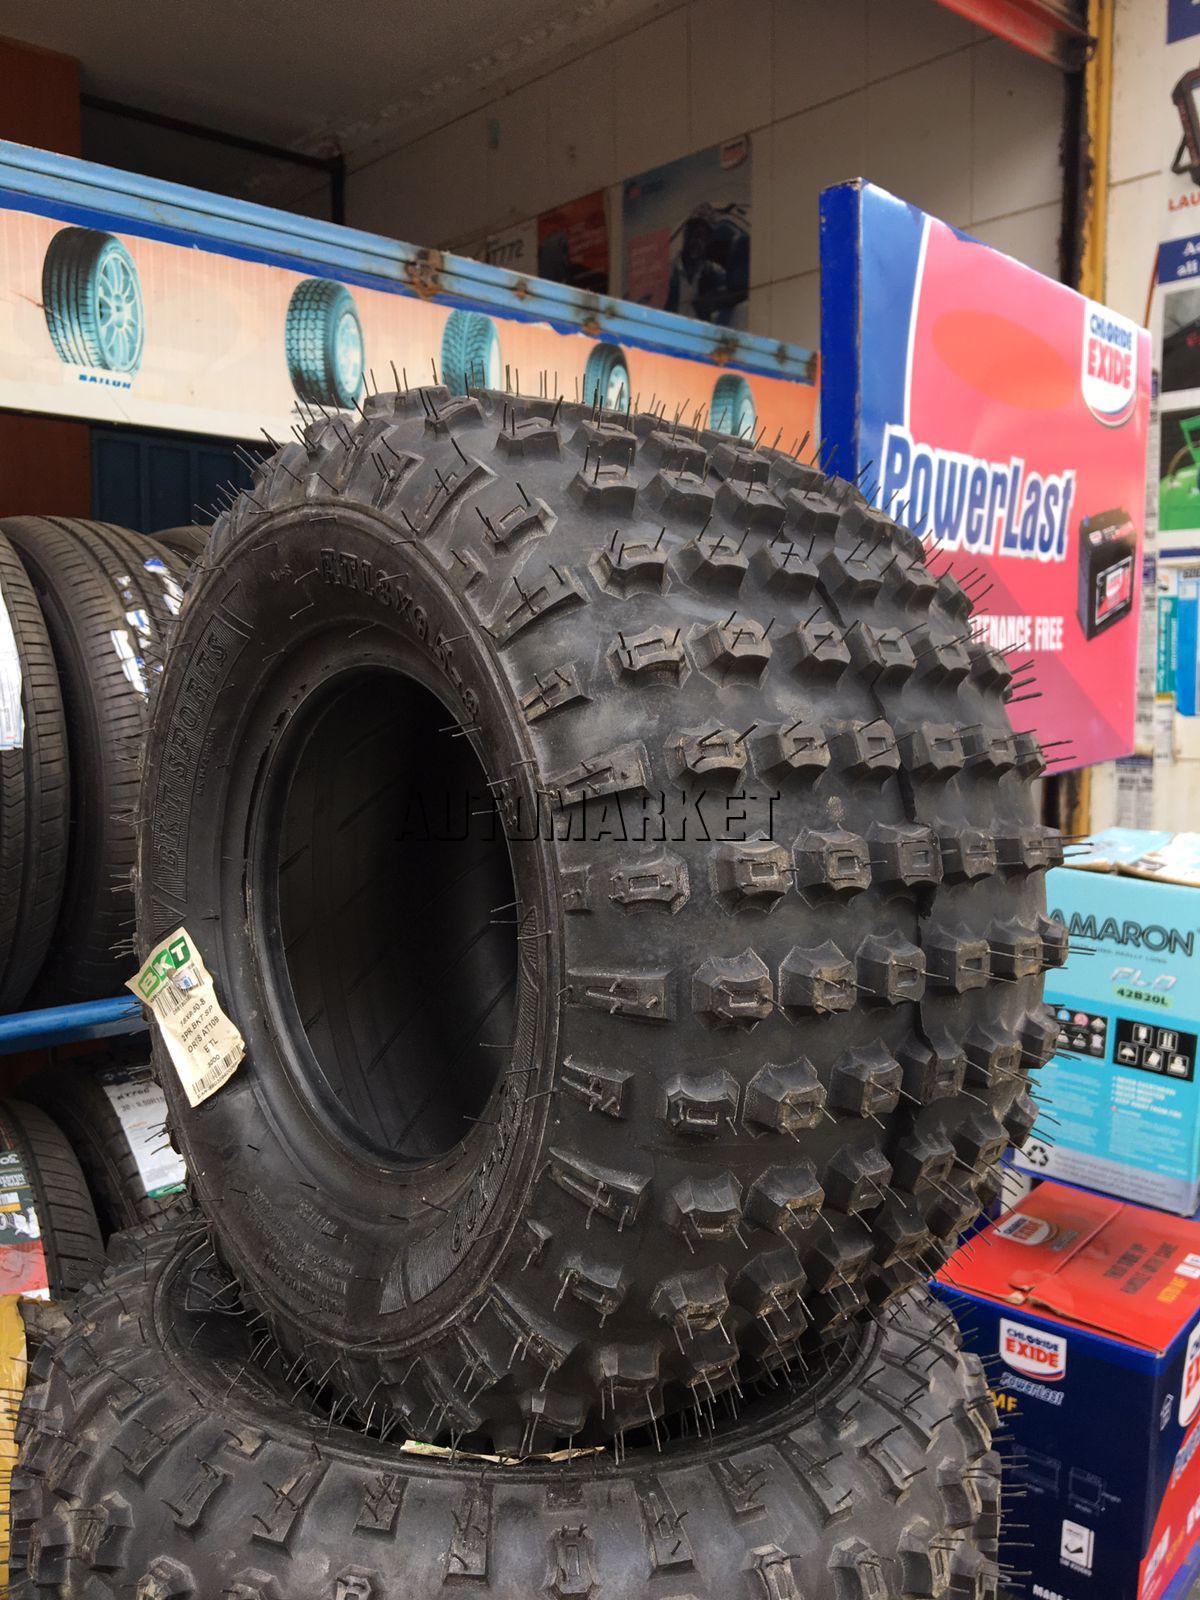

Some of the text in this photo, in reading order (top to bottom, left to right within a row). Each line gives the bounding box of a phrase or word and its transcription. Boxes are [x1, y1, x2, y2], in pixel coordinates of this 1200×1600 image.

[1088, 337, 1132, 390] EXIDE
[880, 427, 1075, 560] PowerLast
[1034, 614, 1064, 652] FREE
[167, 630, 229, 778] SPORTS
[157, 781, 190, 873] BKT
[139, 938, 190, 998] BKT
[187, 1034, 203, 1053] ORTS
[191, 1013, 205, 1030] BKT
[1006, 1337, 1060, 1368] EXIDE
[1007, 1327, 1059, 1352] CHLORIDE
